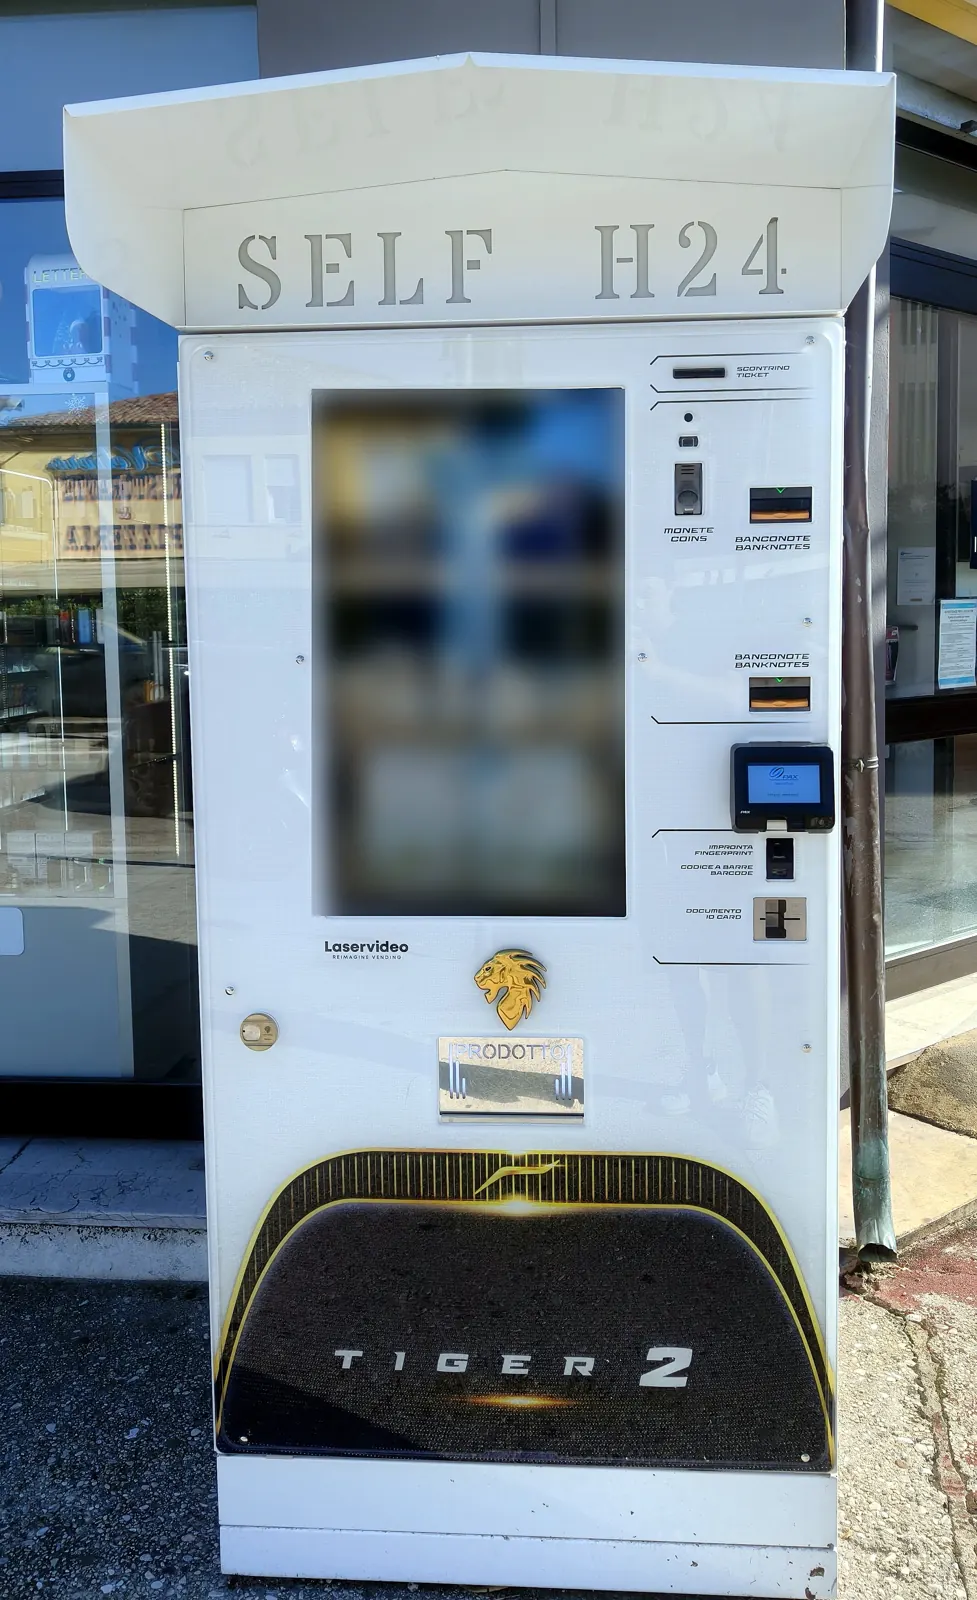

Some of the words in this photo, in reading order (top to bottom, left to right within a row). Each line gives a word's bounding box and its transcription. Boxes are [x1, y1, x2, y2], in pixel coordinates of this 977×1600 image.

[238, 227, 493, 311] SELF
[594, 216, 787, 300] H24
[735, 535, 811, 543] BANCONOTE
[735, 543, 811, 551] BANKNOTES
[734, 653, 810, 661] BANCONOTE
[735, 661, 810, 669] BANKNOTES
[324, 940, 409, 953] Laservideo
[334, 1349, 595, 1377] TIGER
[638, 1346, 693, 1388] 2
